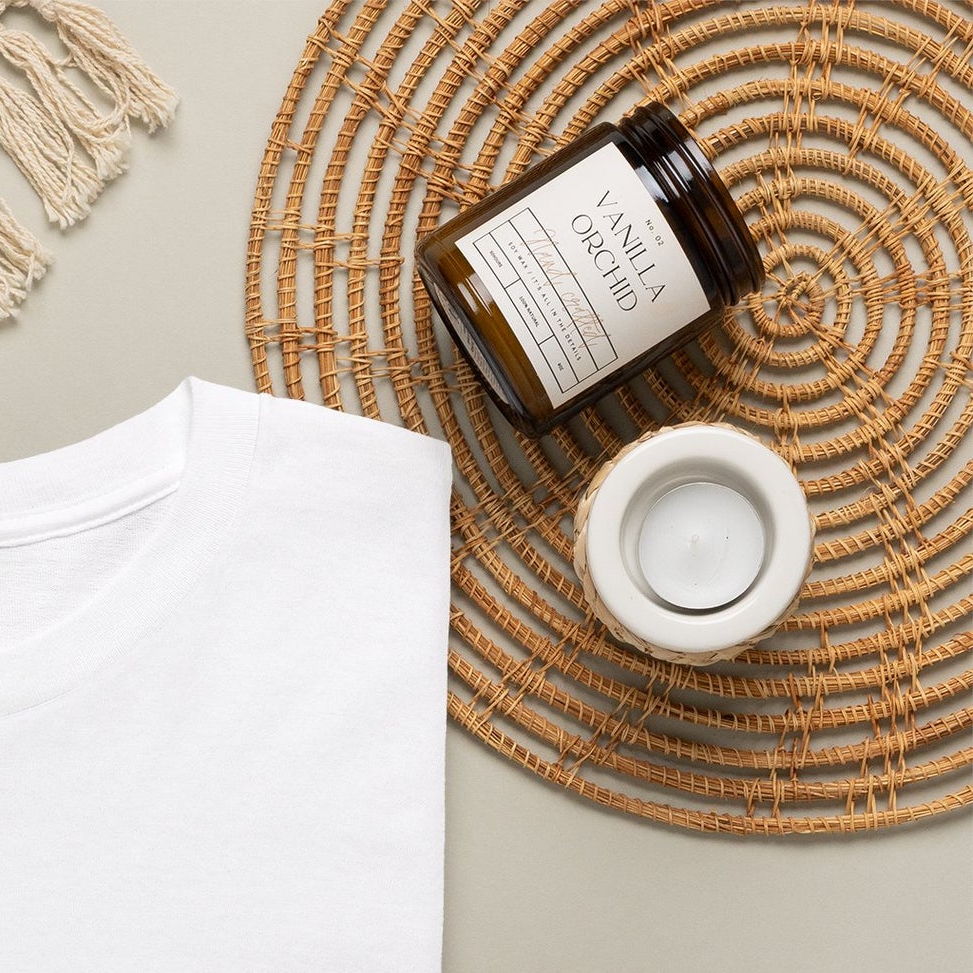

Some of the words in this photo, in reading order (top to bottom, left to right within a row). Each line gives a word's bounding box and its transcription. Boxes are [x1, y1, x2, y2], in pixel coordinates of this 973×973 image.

[571, 214, 637, 311] ORCHID
[596, 190, 666, 302] VANILLA
[645, 219, 655, 234] No.
[655, 235, 664, 246] 02
[507, 241, 518, 253] SOY
[517, 255, 528, 269] WAX
[531, 276, 542, 291] IT'S
[541, 293, 551, 306] ALL
[550, 308, 557, 317] IN
[556, 318, 566, 332] THE
[565, 334, 581, 361] DETAILS
